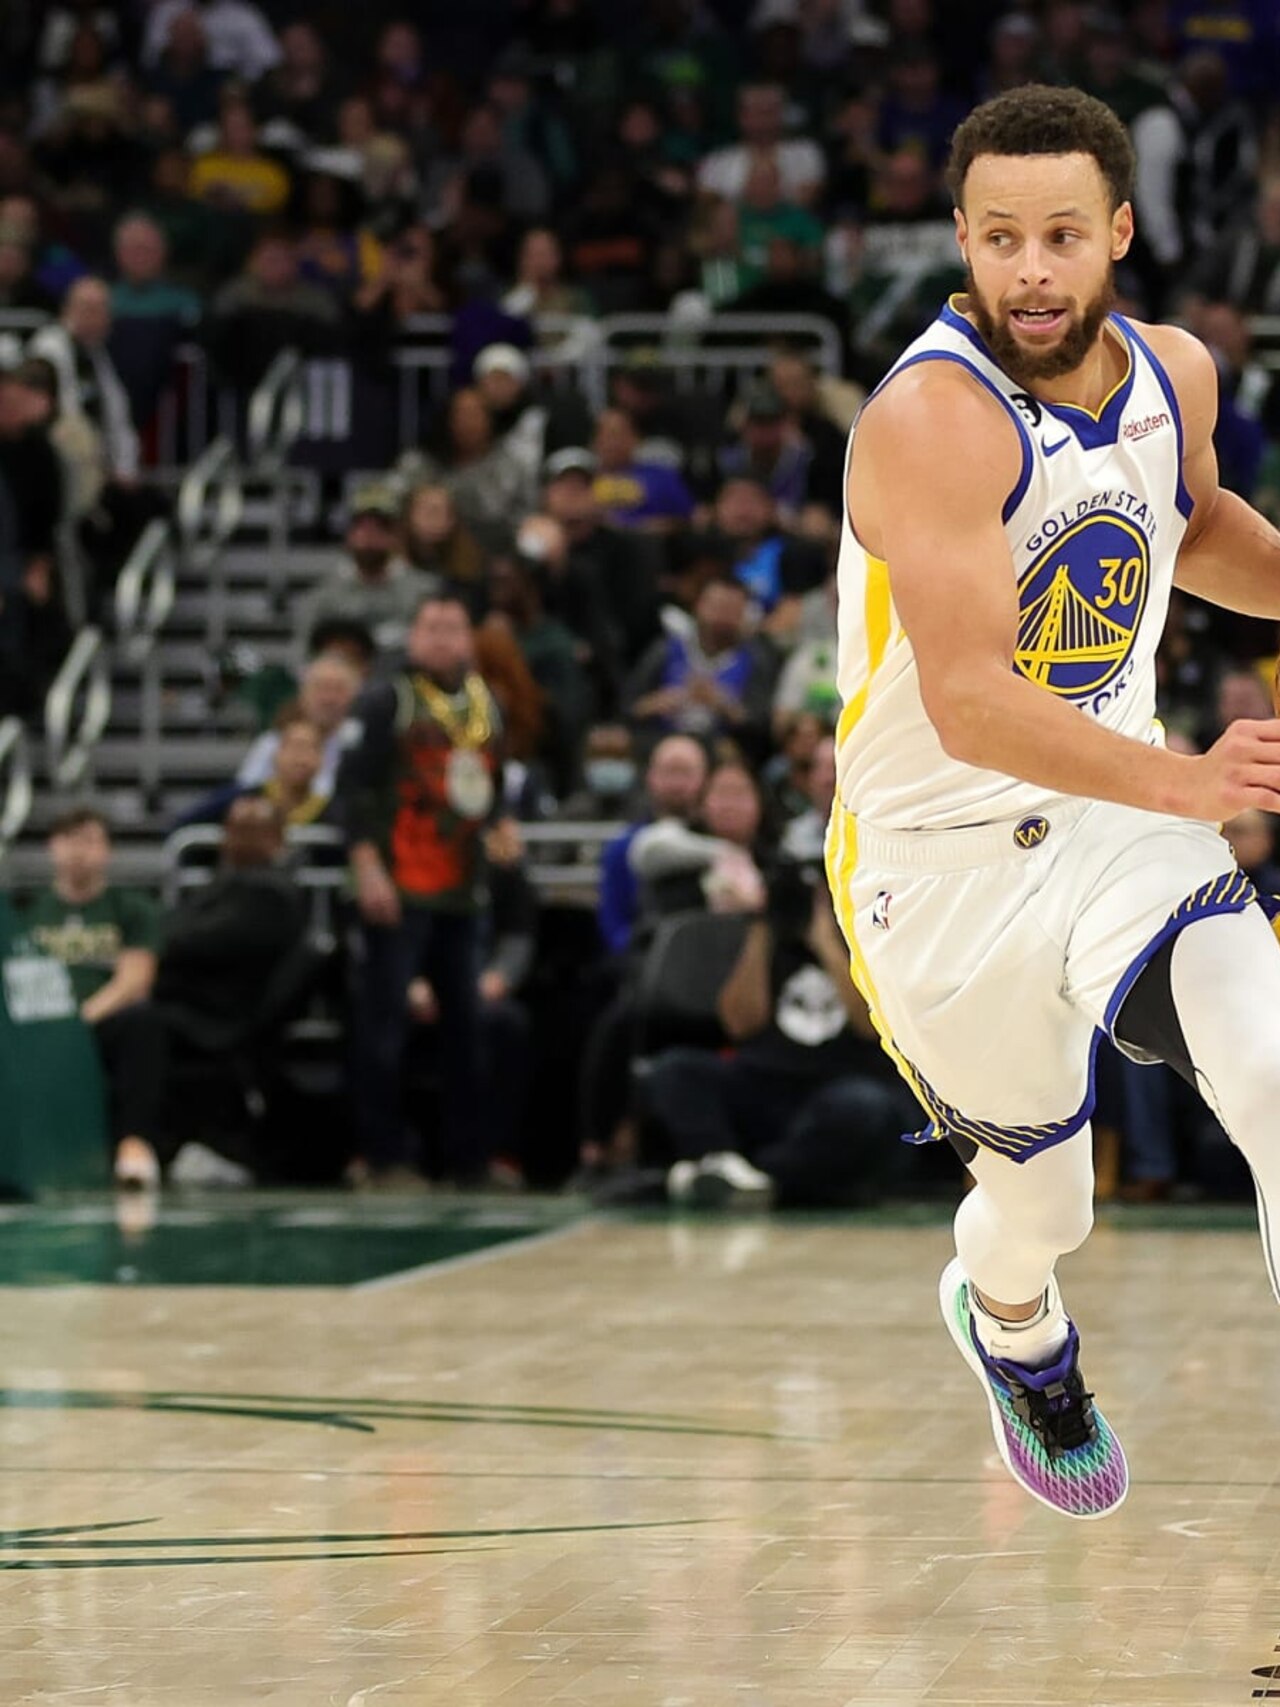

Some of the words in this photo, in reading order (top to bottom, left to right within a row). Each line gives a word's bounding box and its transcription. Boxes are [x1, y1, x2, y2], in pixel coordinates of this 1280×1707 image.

[1026, 490, 1112, 551] GOLDEN
[1095, 557, 1142, 609] 30
[1015, 821, 1046, 846] W
